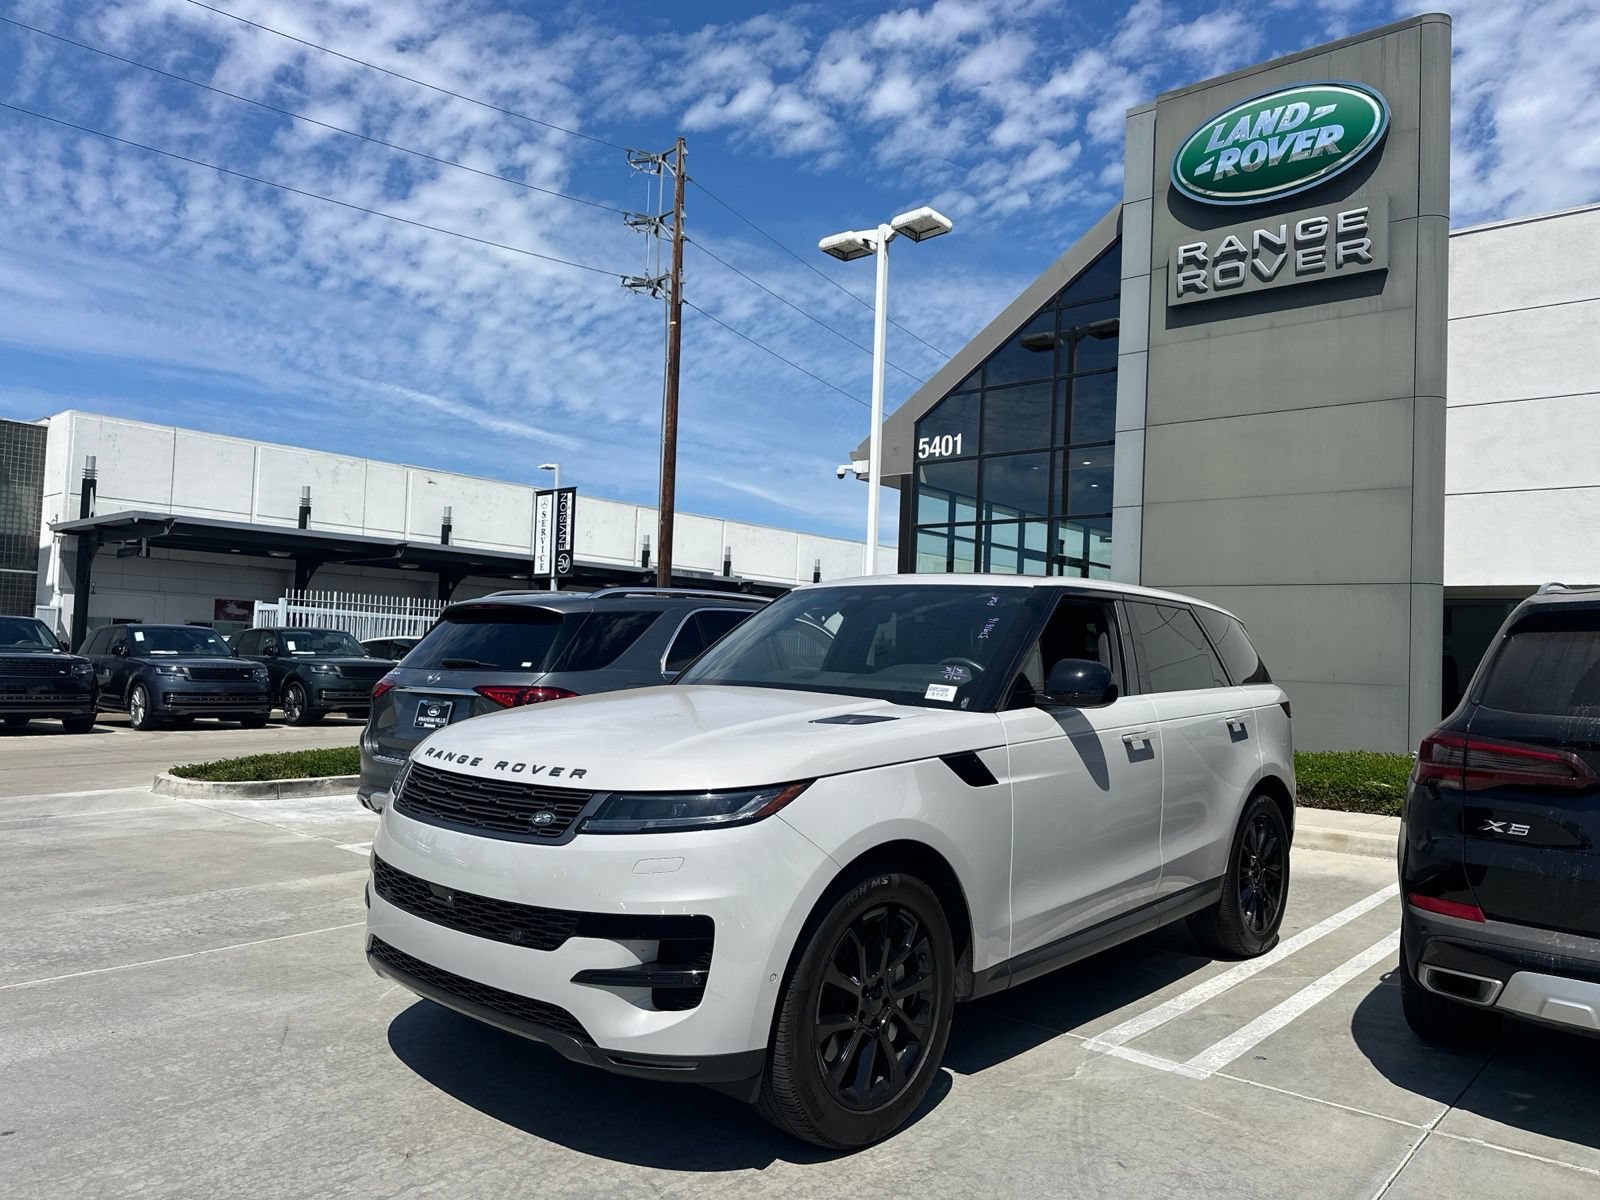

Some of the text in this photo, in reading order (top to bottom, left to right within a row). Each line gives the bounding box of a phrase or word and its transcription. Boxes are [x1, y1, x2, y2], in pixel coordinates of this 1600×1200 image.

[1203, 101, 1311, 154] LAND
[1212, 124, 1344, 182] ROVER
[1177, 206, 1369, 266] RANGE
[1177, 237, 1373, 296] ROVER
[918, 433, 963, 459] 5401
[558, 492, 568, 551] ENVISION
[424, 747, 588, 779] RANGE ROVER
[1478, 819, 1530, 836] X5
